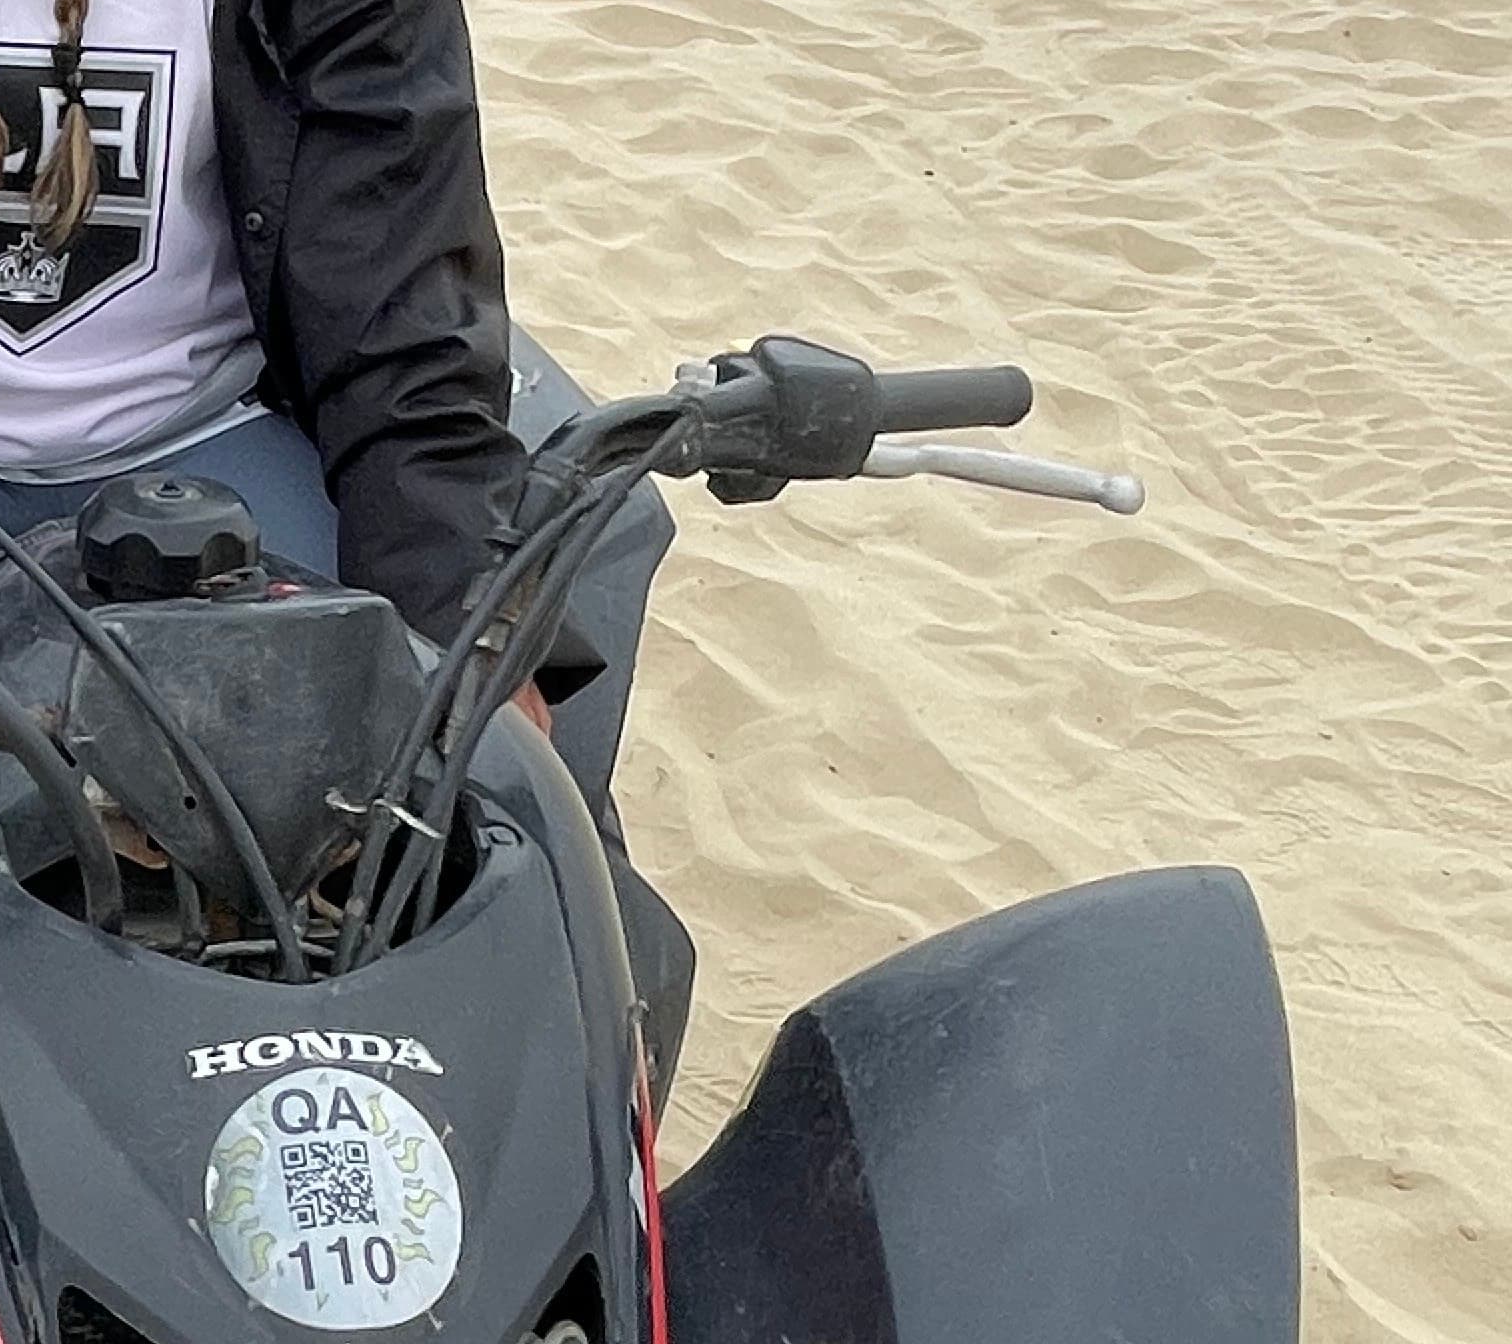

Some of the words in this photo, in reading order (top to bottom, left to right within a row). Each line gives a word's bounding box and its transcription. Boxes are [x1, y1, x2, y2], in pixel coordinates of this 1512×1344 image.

[188, 1031, 444, 1078] HONDA
[270, 1086, 369, 1134] QA
[287, 1236, 397, 1291] 110
